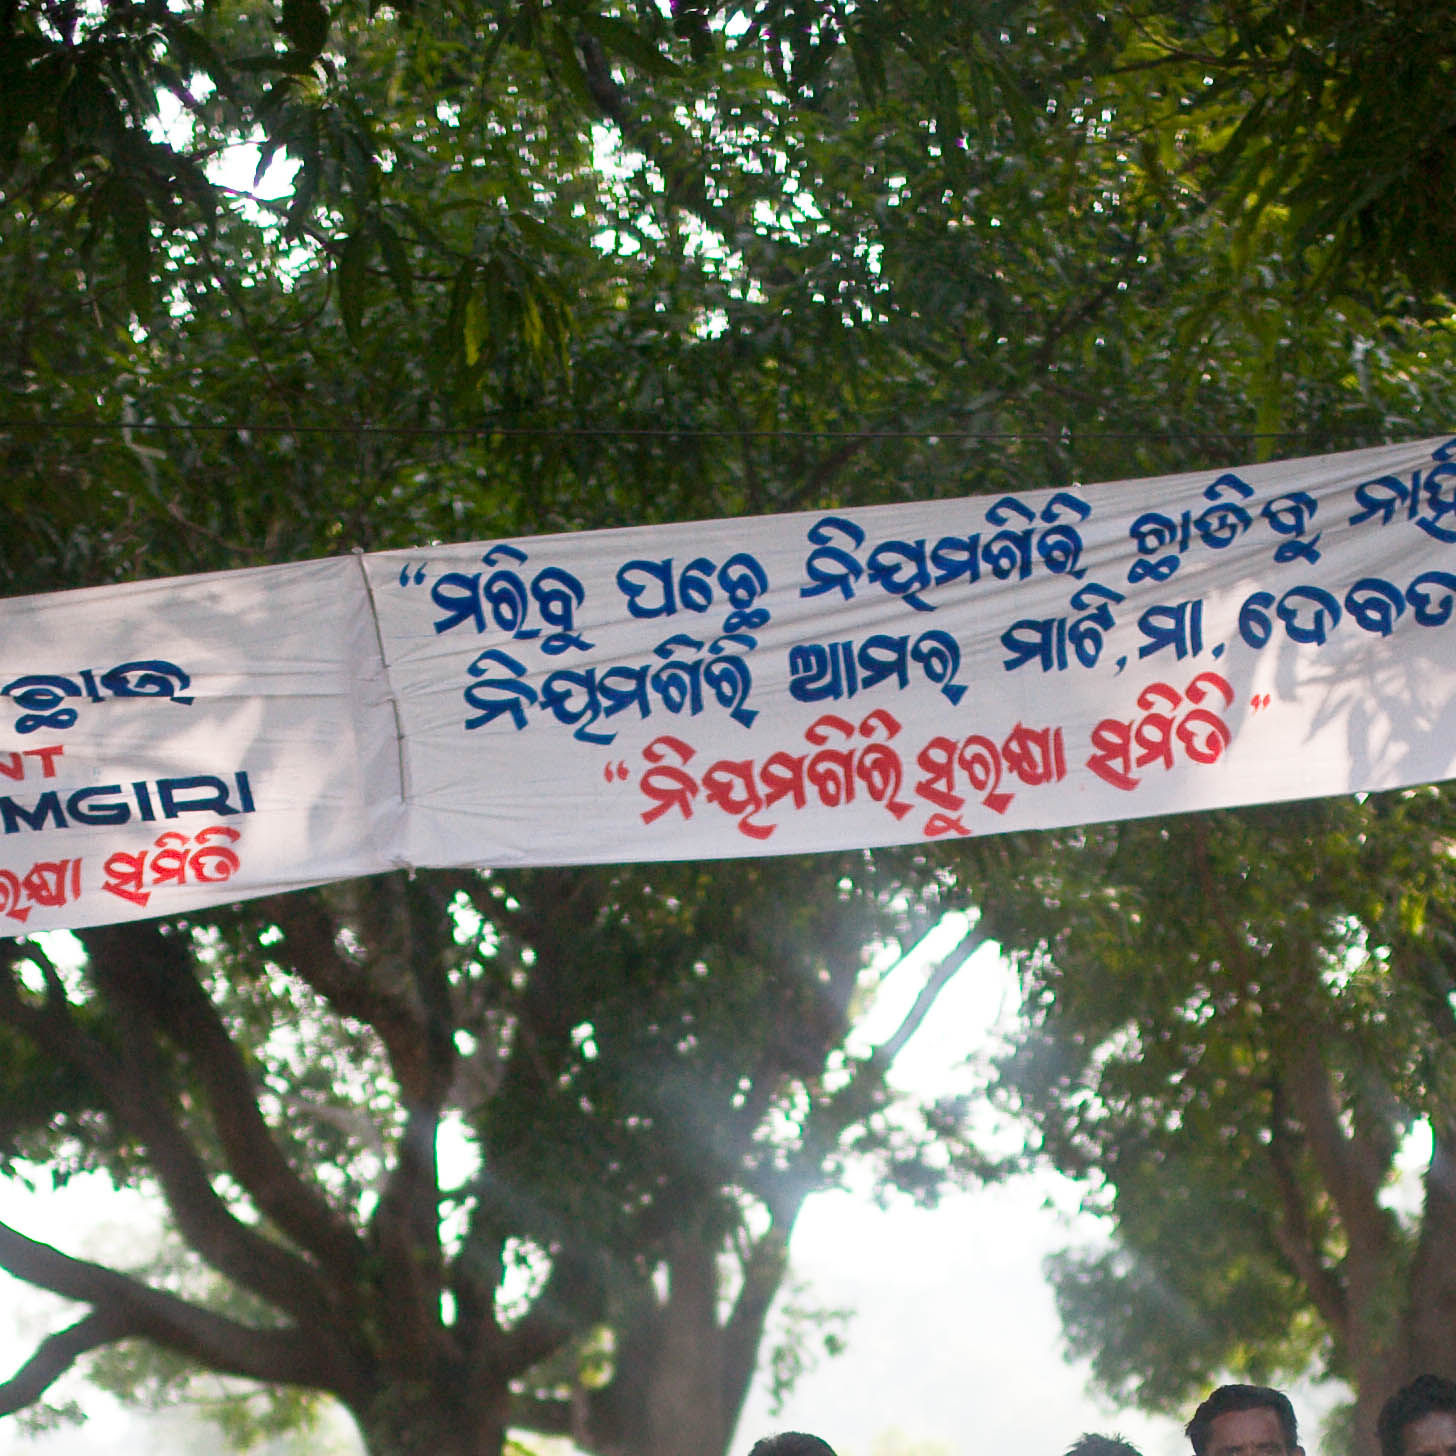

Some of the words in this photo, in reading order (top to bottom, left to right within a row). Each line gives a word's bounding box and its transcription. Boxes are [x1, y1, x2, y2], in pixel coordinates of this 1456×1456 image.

[616, 553, 770, 633] ପଛେ
[800, 492, 1092, 611] ନିୟମଗିରି
[464, 634, 760, 745] ନିୟମଗିରି
[789, 630, 968, 706] ଆମର
[102, 826, 240, 907] ସମିତି
